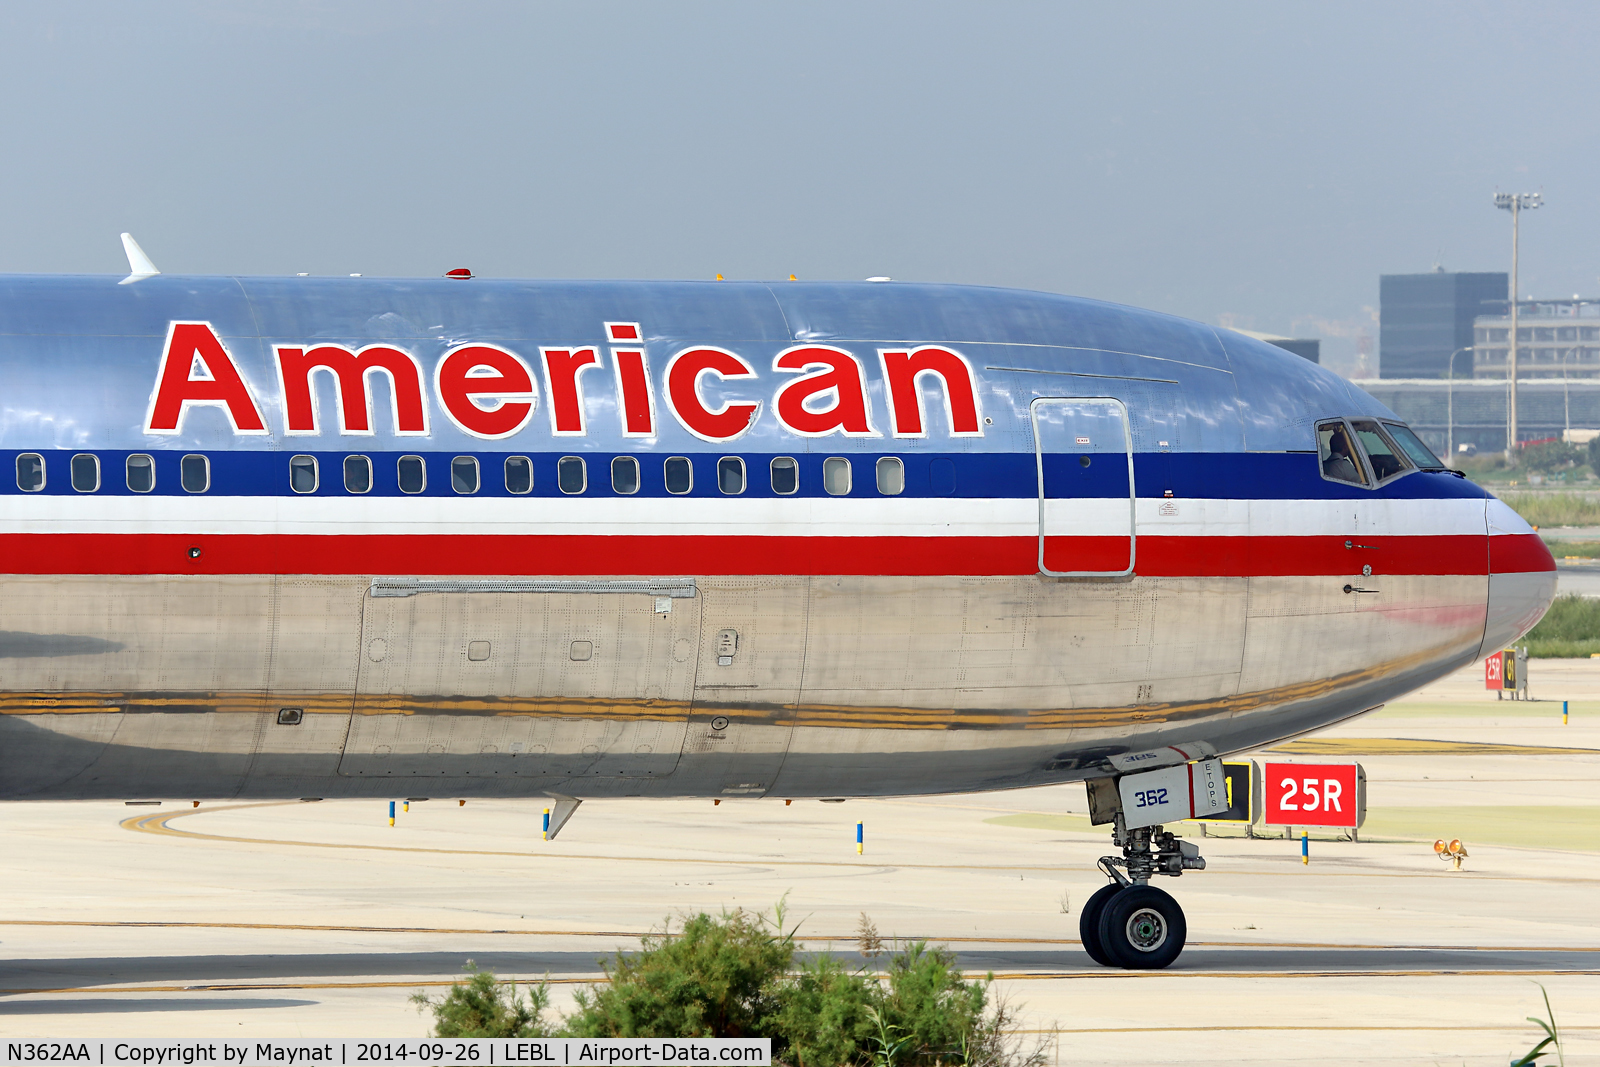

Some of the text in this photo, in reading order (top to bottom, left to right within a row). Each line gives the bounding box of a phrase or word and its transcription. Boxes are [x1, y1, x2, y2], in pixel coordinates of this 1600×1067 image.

[143, 320, 985, 442] American
[1487, 658, 1501, 680] 25R
[1135, 788, 1169, 808] 362
[1205, 763, 1217, 807] ETOPS
[1279, 778, 1342, 812] 25R
